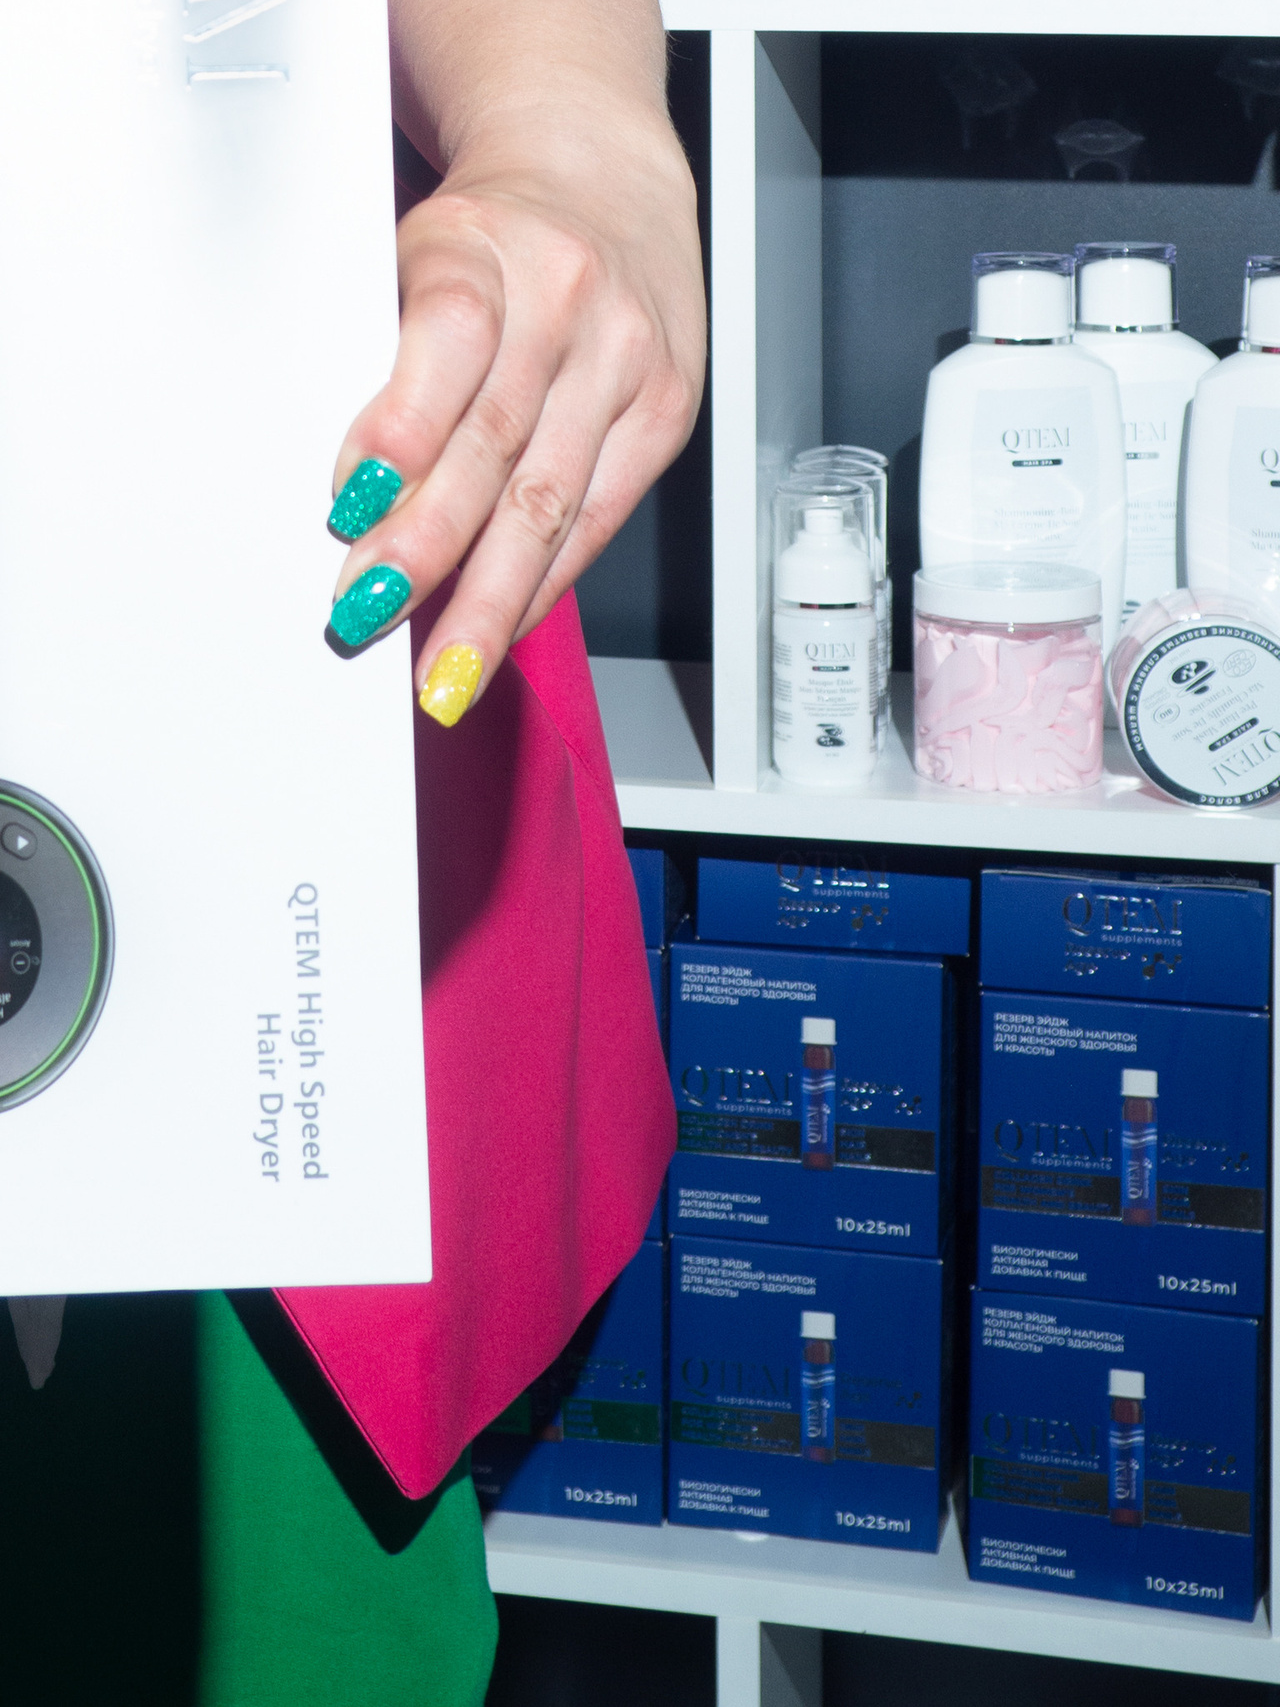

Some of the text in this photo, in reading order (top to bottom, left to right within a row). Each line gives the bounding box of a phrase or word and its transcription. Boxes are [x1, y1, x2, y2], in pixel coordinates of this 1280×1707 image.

[1002, 427, 1071, 454] QTEM
[1160, 626, 1208, 655] ВЗБИТЫЕ
[805, 642, 856, 662] QTEM
[1131, 652, 1160, 692] СЛИВКИ
[1158, 707, 1174, 720] BIO
[1125, 705, 1143, 752] ШЕЛКОМ
[1214, 722, 1252, 747] HAIR SPA
[1213, 726, 1280, 786] QTEM
[1199, 794, 1241, 805] ВОЛОС
[813, 887, 890, 900] supplements
[1062, 893, 1183, 937] QTEM
[1101, 933, 1183, 947] supplements
[681, 963, 752, 977] РЕЗЕРВ ЭЙДЖ
[681, 974, 817, 992] КОЛЛАГЕНОВЫЙ НАПИТОК
[681, 983, 816, 1002] ДЛЯ ЖЕНСКОГО ЗДОРОВЬЯ
[692, 994, 739, 1005] КРАСОТЫ
[995, 1012, 1069, 1027] РЕЗЕРВ ЭЙДЖ
[288, 882, 329, 1179] QTEM High Speed
[995, 1023, 1137, 1042] КОЛЛАГЕНОВЫЙ НАПИТОК
[995, 1033, 1137, 1053] ДЛЯ ЖЕНСКОГО ЗДОРОВЬЯ
[1005, 1045, 1055, 1057] КРАСОТЫ
[680, 1065, 793, 1107] QTEM
[253, 1013, 284, 1182] Hair Dryer
[715, 1102, 792, 1116] supplements
[994, 1119, 1113, 1162] QTEM
[1031, 1157, 1112, 1170] supplements
[679, 1188, 761, 1204] БИОЛОГИЧЕСКИ
[679, 1199, 732, 1211] АКТИВНАЯ
[679, 1208, 769, 1225] ДОБАВКА ПИЩЕ
[836, 1217, 911, 1237] 10x25ml
[992, 1244, 1078, 1260] БИОЛОГИЧЕСКИ
[682, 1254, 752, 1270] РЕЗЕРВ ЭЙДЖ
[992, 1256, 1048, 1268] АКТИВНАЯ
[682, 1265, 816, 1285] КОЛЛАГЕНОВЫЙ НАПИТОК
[992, 1265, 1087, 1282] ДОБАВКА ПИЩЕ
[682, 1274, 816, 1295] ДЛЯ ЖЕНСКОГО ЗДОРОВЬЯ
[692, 1286, 739, 1298] КРАСОТЫ
[1158, 1275, 1237, 1295] 10x25ml
[983, 1307, 1057, 1324] РЕЗЕРВ ЭЙДЖ
[983, 1318, 1124, 1343] КОЛЛАГЕНОВЫЙ НАПИТОК
[983, 1328, 1124, 1352] ДЛЯ ЖЕНСКОГО ЗДОРОВЬЯ
[994, 1340, 1043, 1353] КРАСОТЫ
[716, 1395, 792, 1409] supplements
[1019, 1452, 1099, 1470] supplements
[564, 1486, 638, 1507] 10x25ml
[679, 1479, 761, 1497] БИОЛОГИЧЕСКИ
[679, 1491, 733, 1503] АКТИВНАЯ
[679, 1499, 769, 1518] ДОБАВКА ПИЩЕ
[836, 1510, 911, 1533] 10x25ml
[981, 1537, 1067, 1557] БИОЛОГИЧЕСКИ
[981, 1548, 1037, 1563] АКТИВНАЯ
[980, 1557, 1076, 1579] ДОБАВКА ПИЩЕ
[1145, 1576, 1224, 1600] 10x25ml
